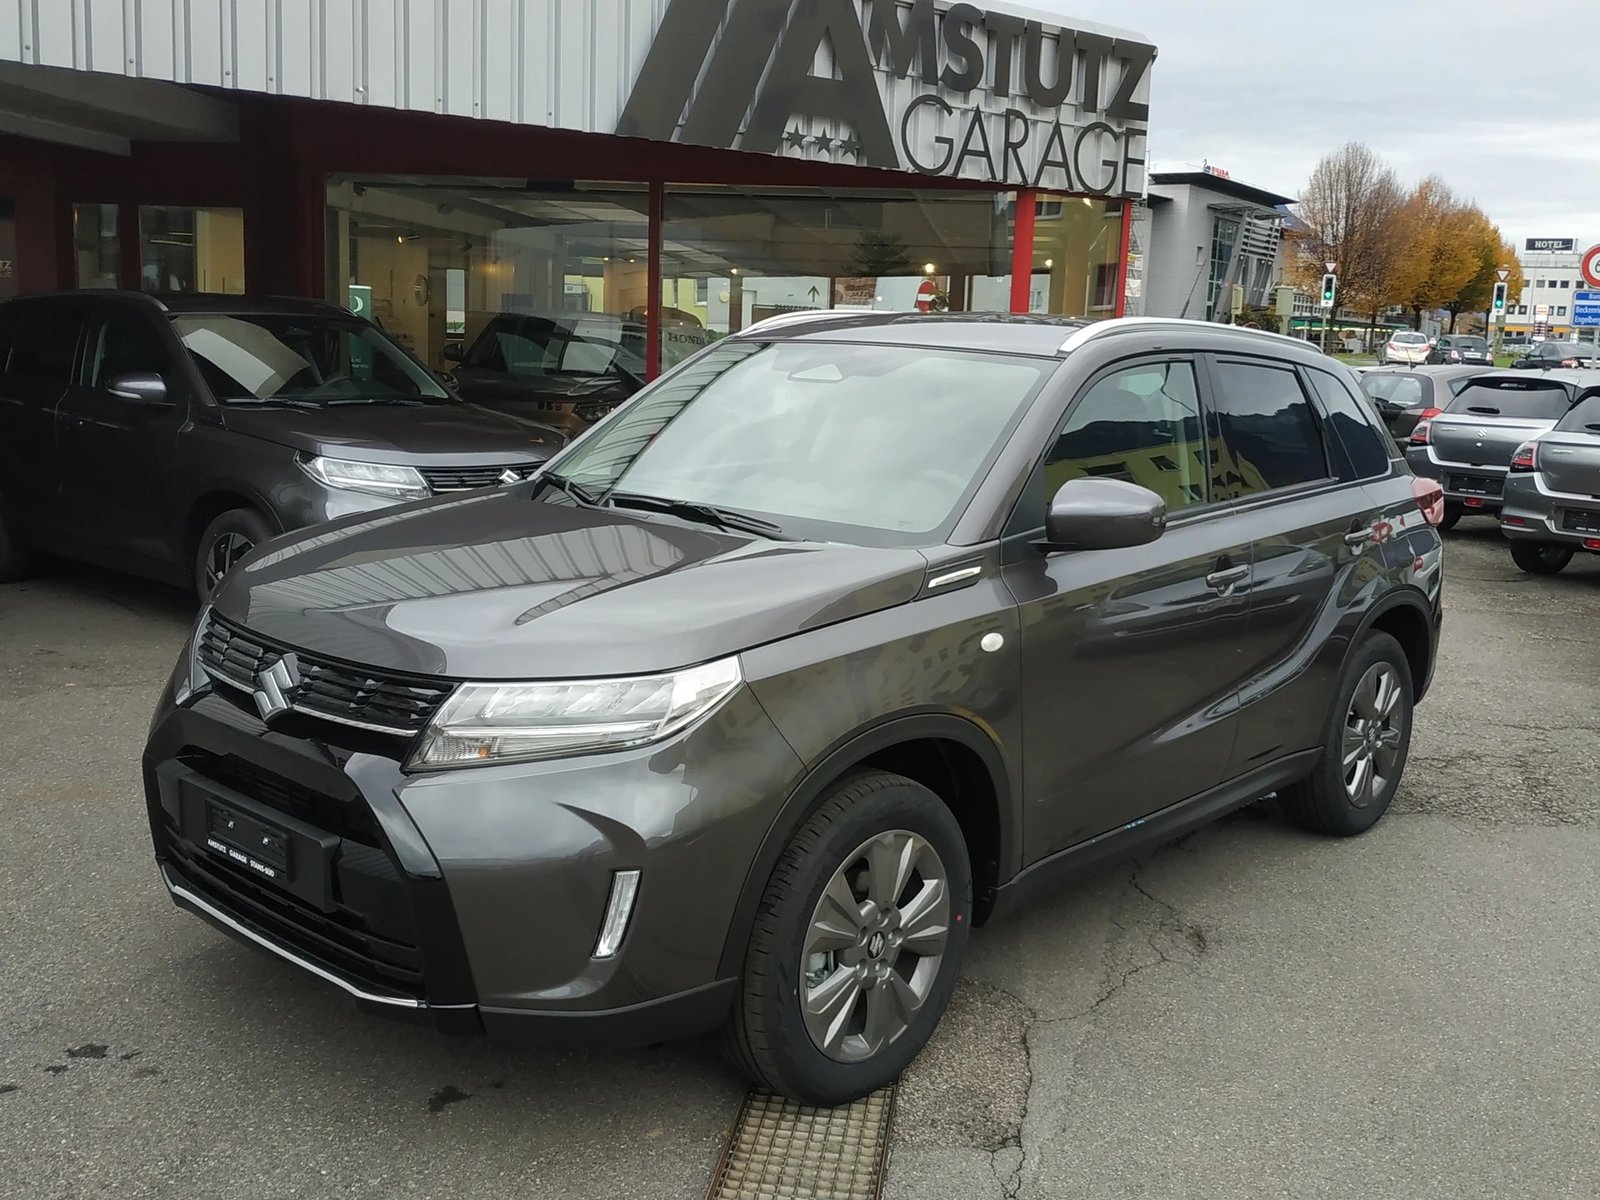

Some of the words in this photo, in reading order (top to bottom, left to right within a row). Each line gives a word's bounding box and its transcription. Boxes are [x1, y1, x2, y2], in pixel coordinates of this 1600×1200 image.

[740, 0, 1159, 169] AMSTUTZ
[901, 93, 1148, 199] GARAGE
[1534, 240, 1563, 249] HOTEL
[1594, 259, 1600, 274] 6
[229, 849, 247, 864] GARAGE
